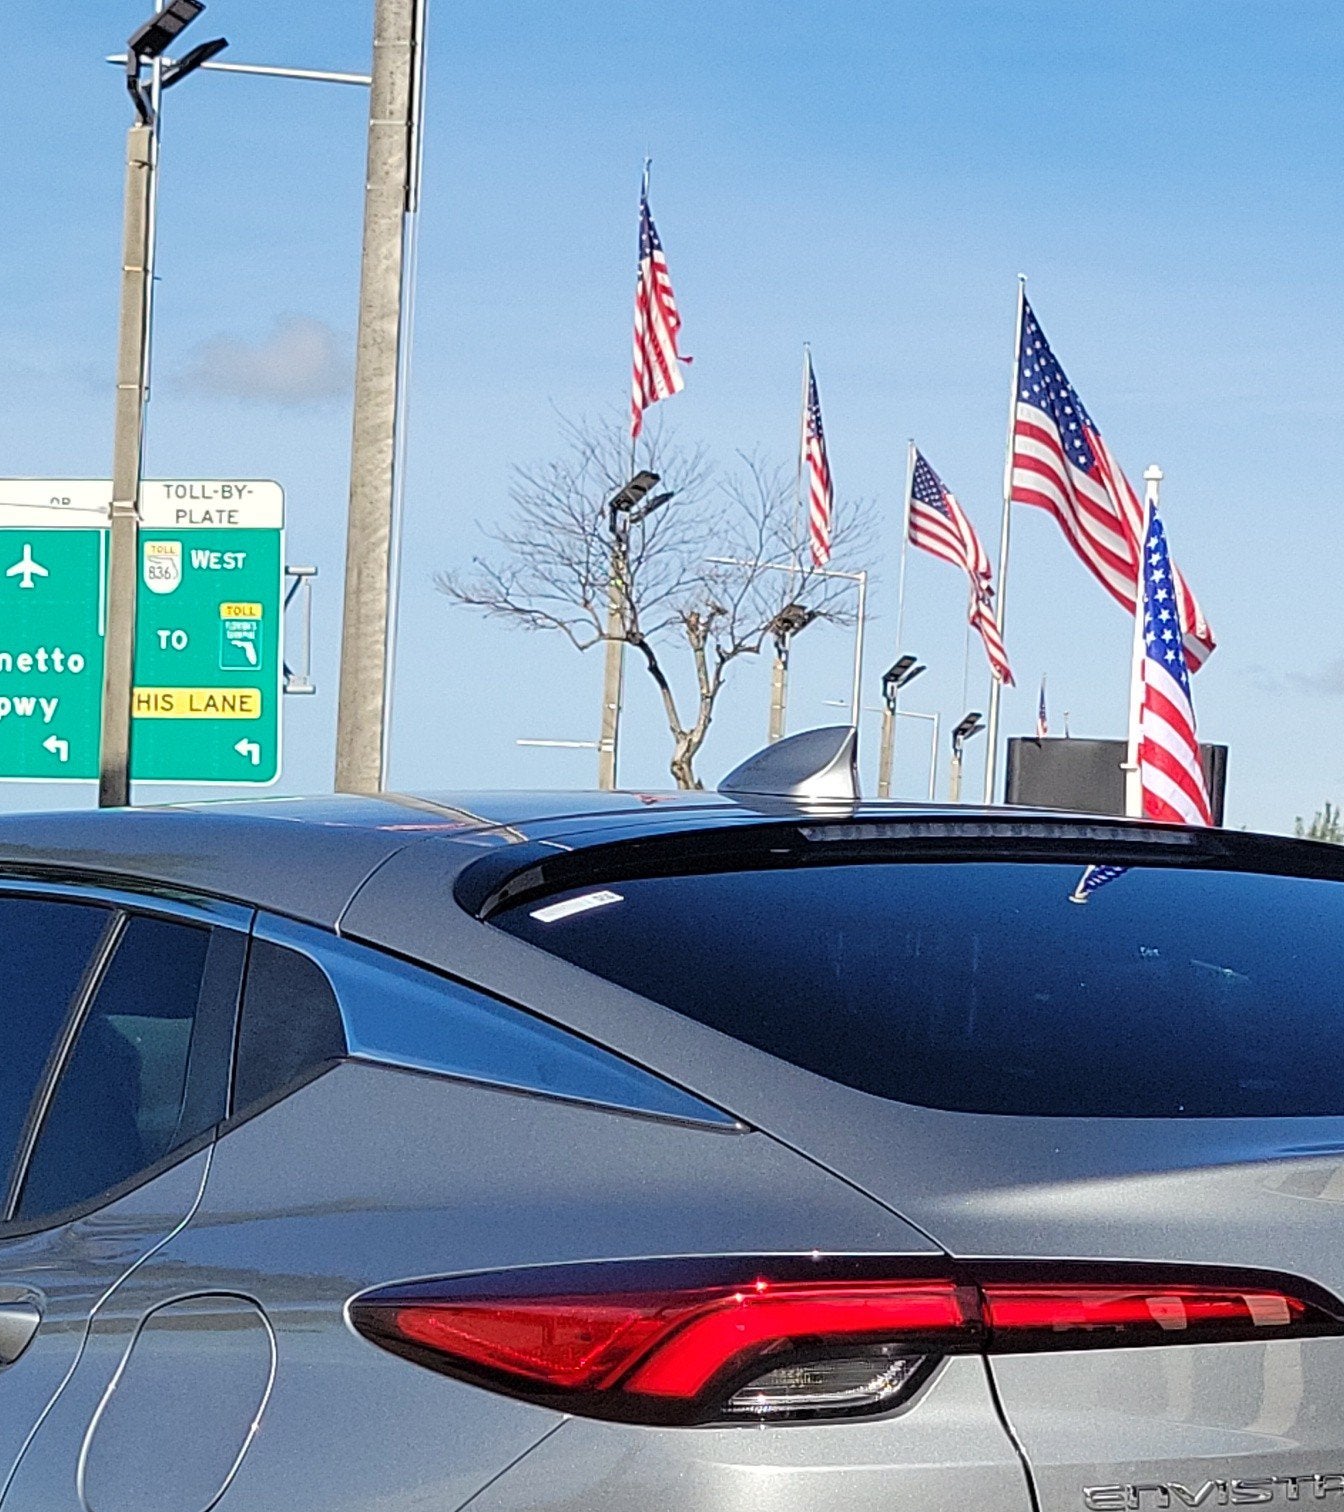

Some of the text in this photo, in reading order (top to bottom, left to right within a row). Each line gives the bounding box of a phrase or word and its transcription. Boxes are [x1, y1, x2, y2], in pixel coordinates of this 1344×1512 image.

[163, 484, 254, 500] TOLL-BY-
[175, 508, 240, 525] PLATE
[151, 545, 176, 554] TOLL
[190, 549, 247, 570] WEST
[148, 565, 172, 580] 836
[226, 605, 256, 617] TOLL
[156, 629, 189, 651] TO
[133, 693, 253, 713] HIS LANE
